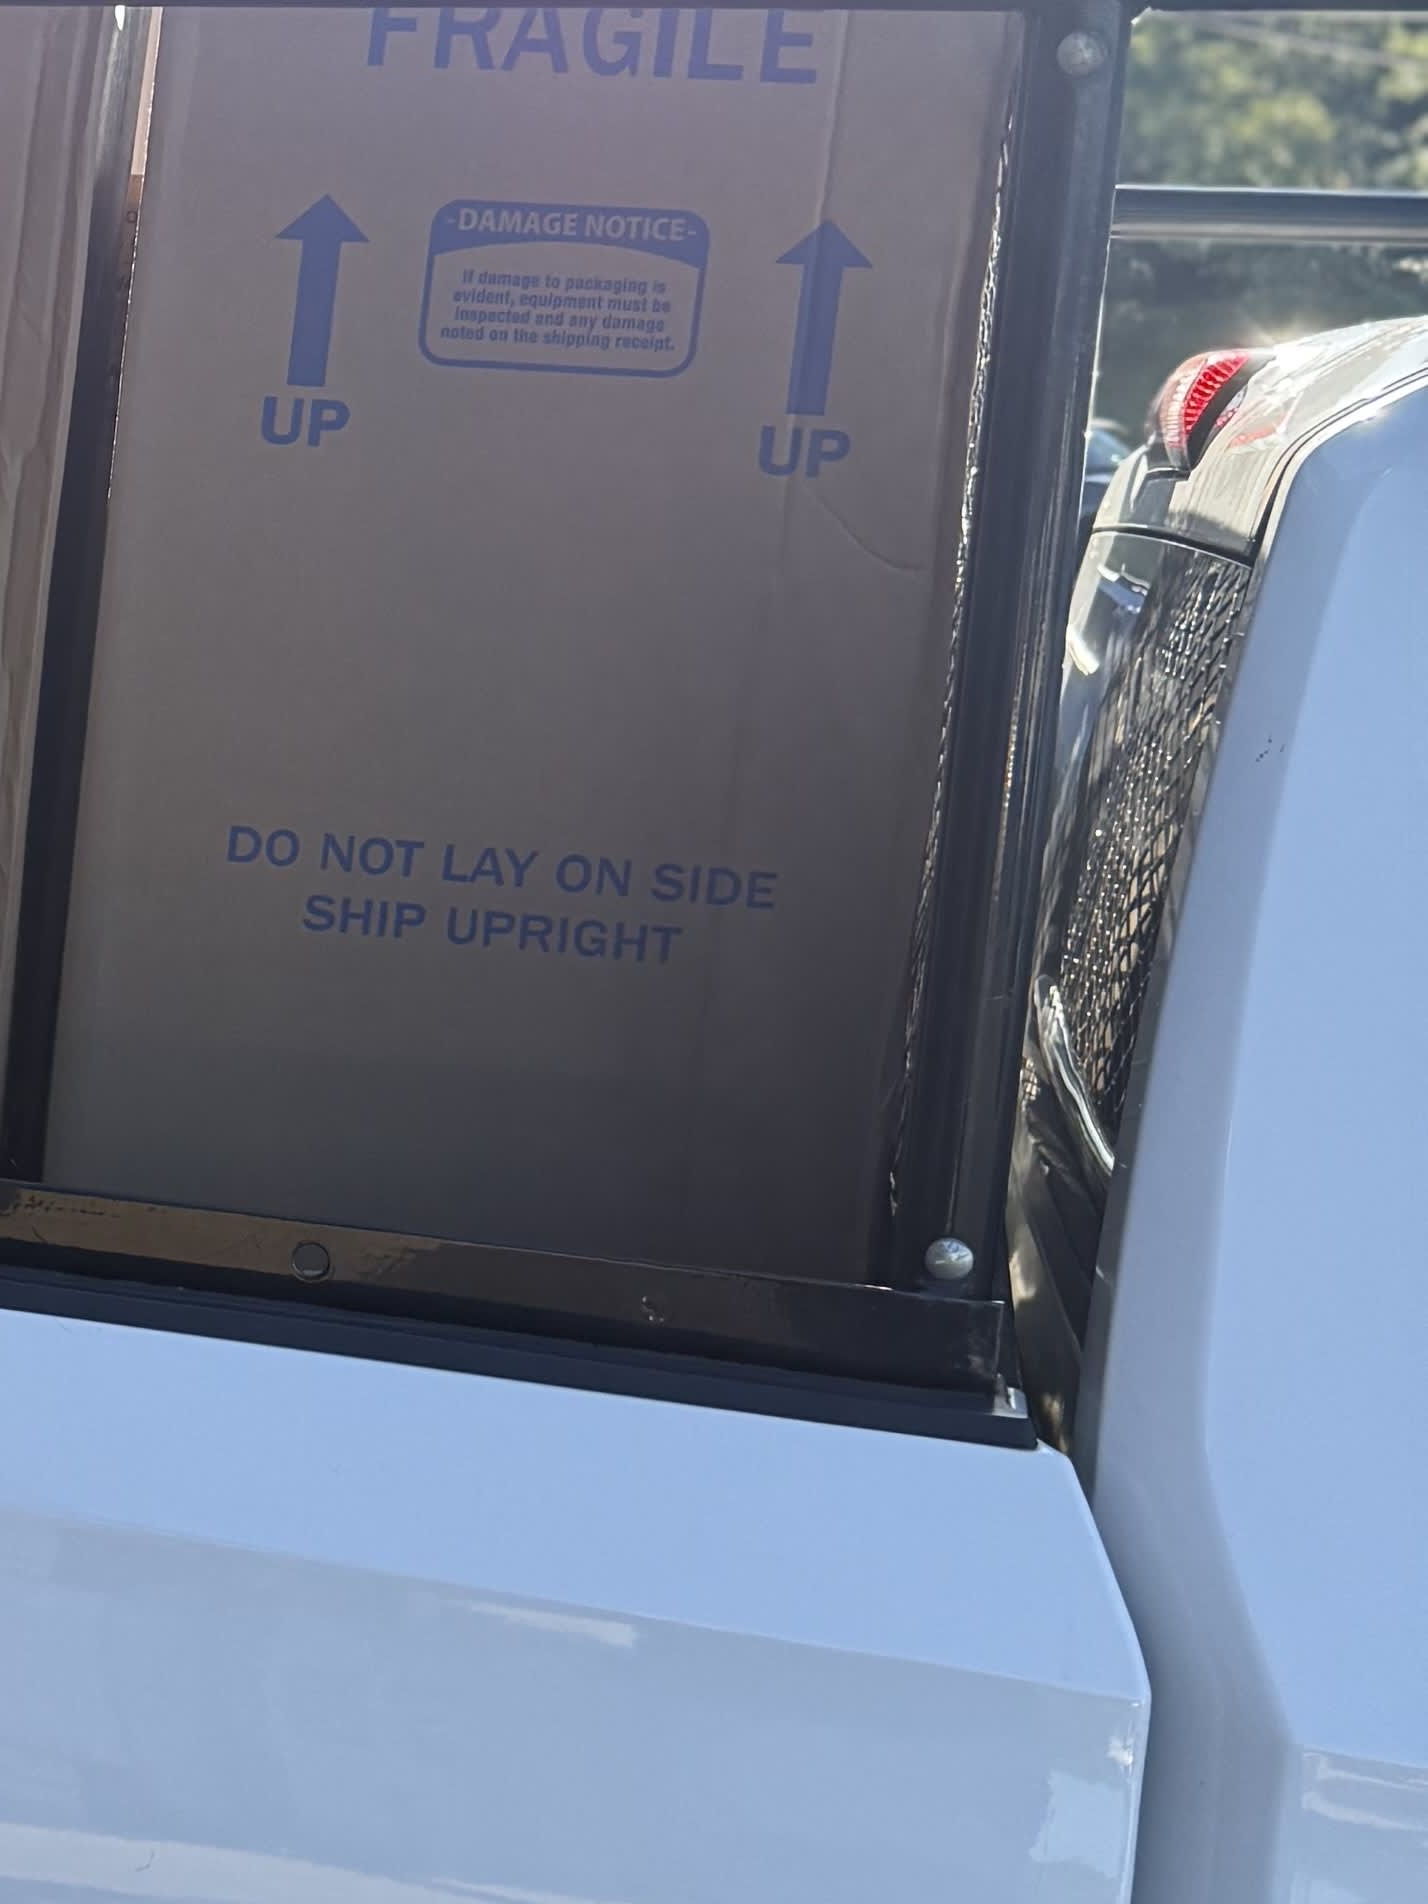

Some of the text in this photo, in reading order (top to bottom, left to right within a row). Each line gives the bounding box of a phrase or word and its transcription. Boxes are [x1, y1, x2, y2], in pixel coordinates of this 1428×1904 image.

[367, 7, 817, 84] FRAGILE
[453, 289, 671, 313] evident, equipment must be
[462, 268, 667, 295] If damage to packaging is
[440, 325, 675, 353] noted on the shipping receipt.
[455, 306, 665, 334] inspected and any damage
[261, 396, 351, 447] UP
[758, 425, 850, 478] UP
[226, 825, 778, 910] DO NOT LAY ON SIDE
[301, 895, 683, 964] SHIP UPRIGHT
